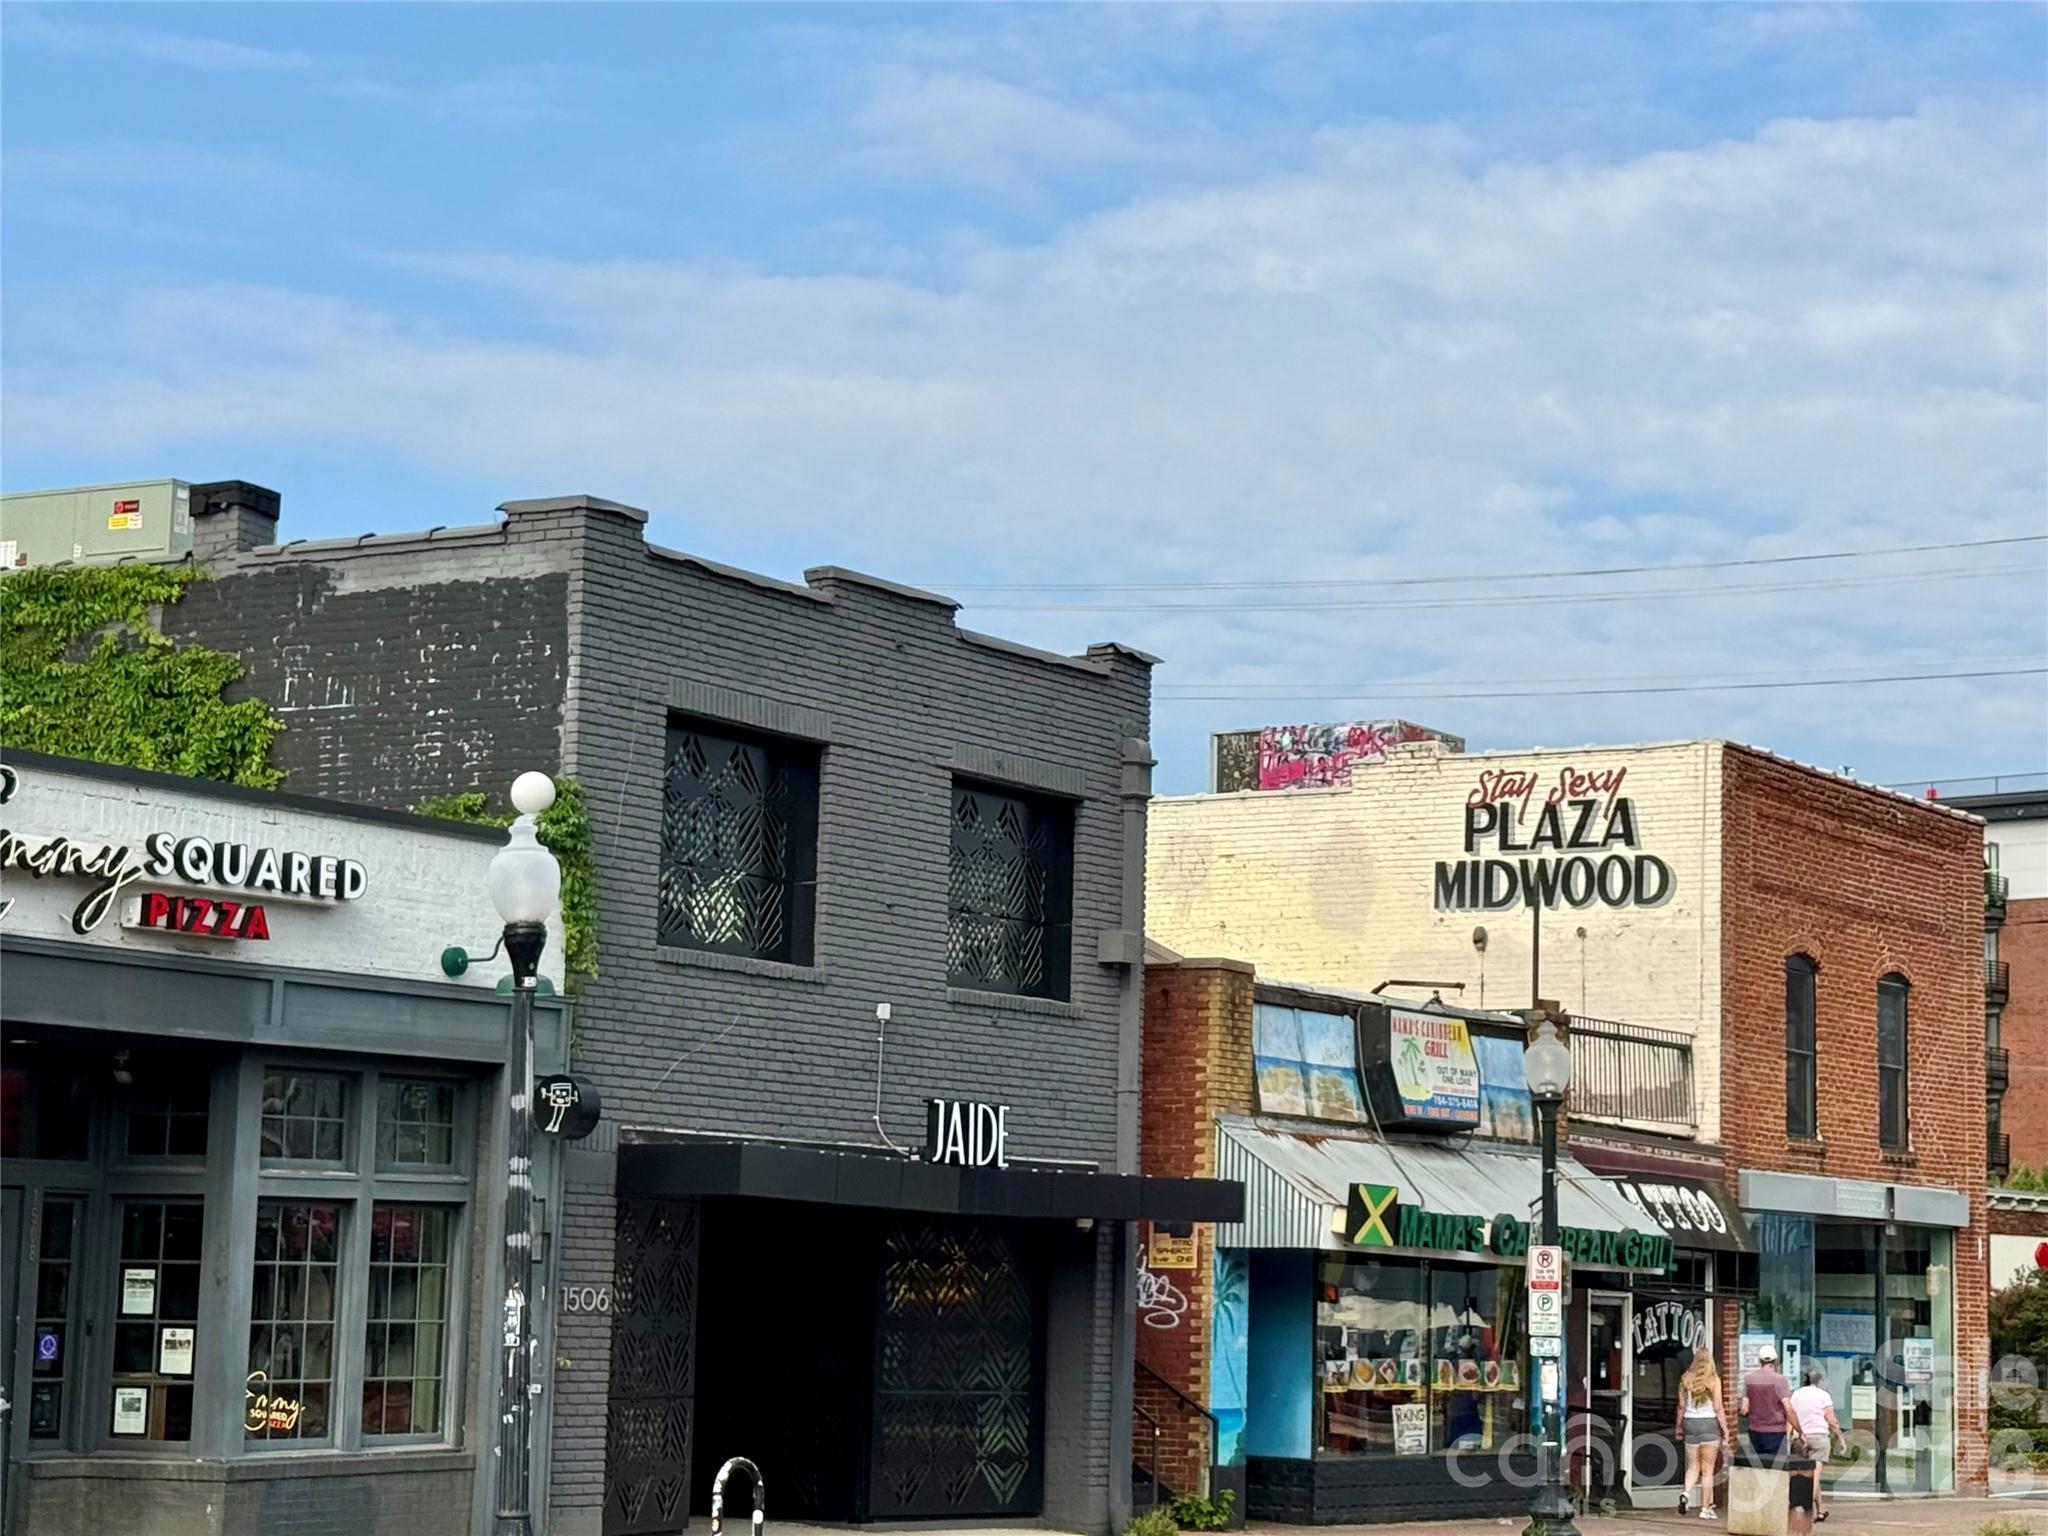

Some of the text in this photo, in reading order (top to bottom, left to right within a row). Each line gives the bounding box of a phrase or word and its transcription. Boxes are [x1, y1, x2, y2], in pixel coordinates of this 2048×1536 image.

[1467, 766, 1628, 825] Stay Sexy
[1465, 798, 1641, 855] PLAZA
[144, 832, 368, 900] SQUARED
[1434, 855, 1677, 913] MIDWOOD
[141, 893, 270, 940] PIZZA
[1424, 1040, 1449, 1058] GRILL
[932, 1099, 1010, 1168] JAIDE
[1399, 1203, 1485, 1252] MAMA'S
[1617, 1226, 1678, 1272] GRILL
[562, 1287, 609, 1312] 1506
